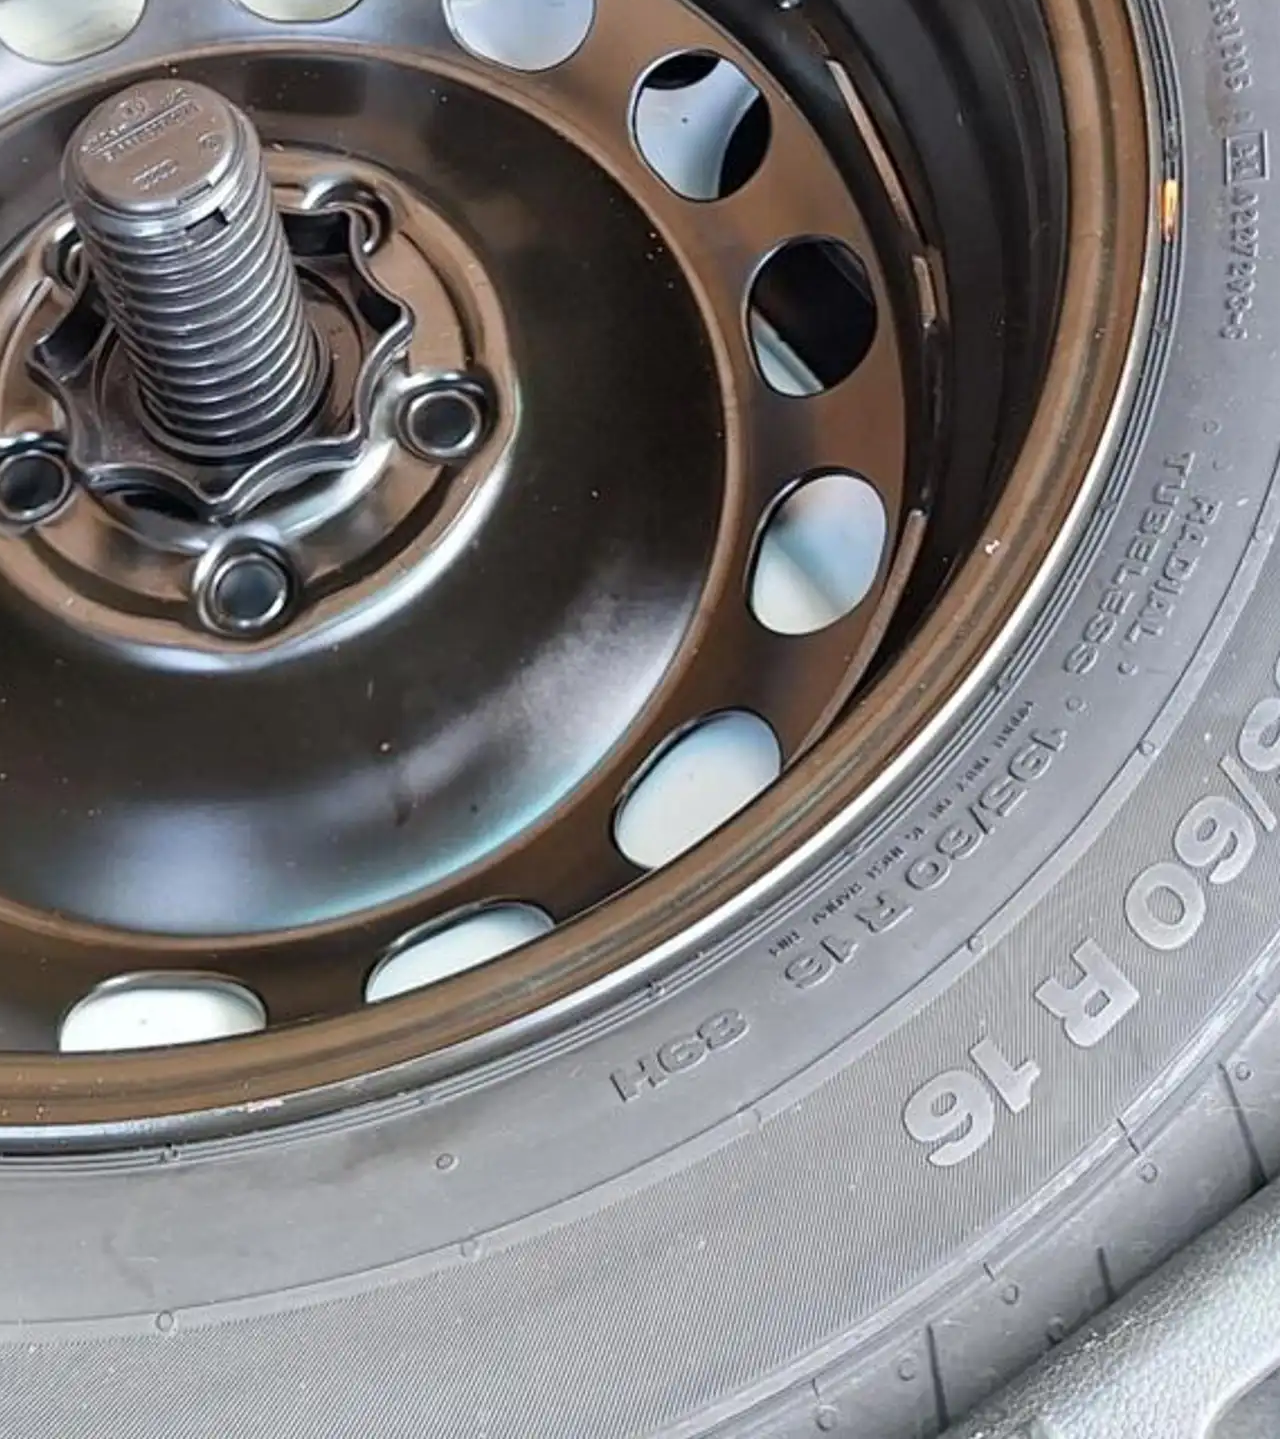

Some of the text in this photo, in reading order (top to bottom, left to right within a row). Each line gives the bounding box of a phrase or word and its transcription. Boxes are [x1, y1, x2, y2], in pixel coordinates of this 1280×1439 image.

[1062, 450, 1195, 676] TUBELESS
[1125, 496, 1222, 647] RADIAL
[607, 726, 1070, 1104] 195/60 R 16 89H
[1034, 937, 1141, 1048] R
[902, 1037, 1040, 1166] 16
